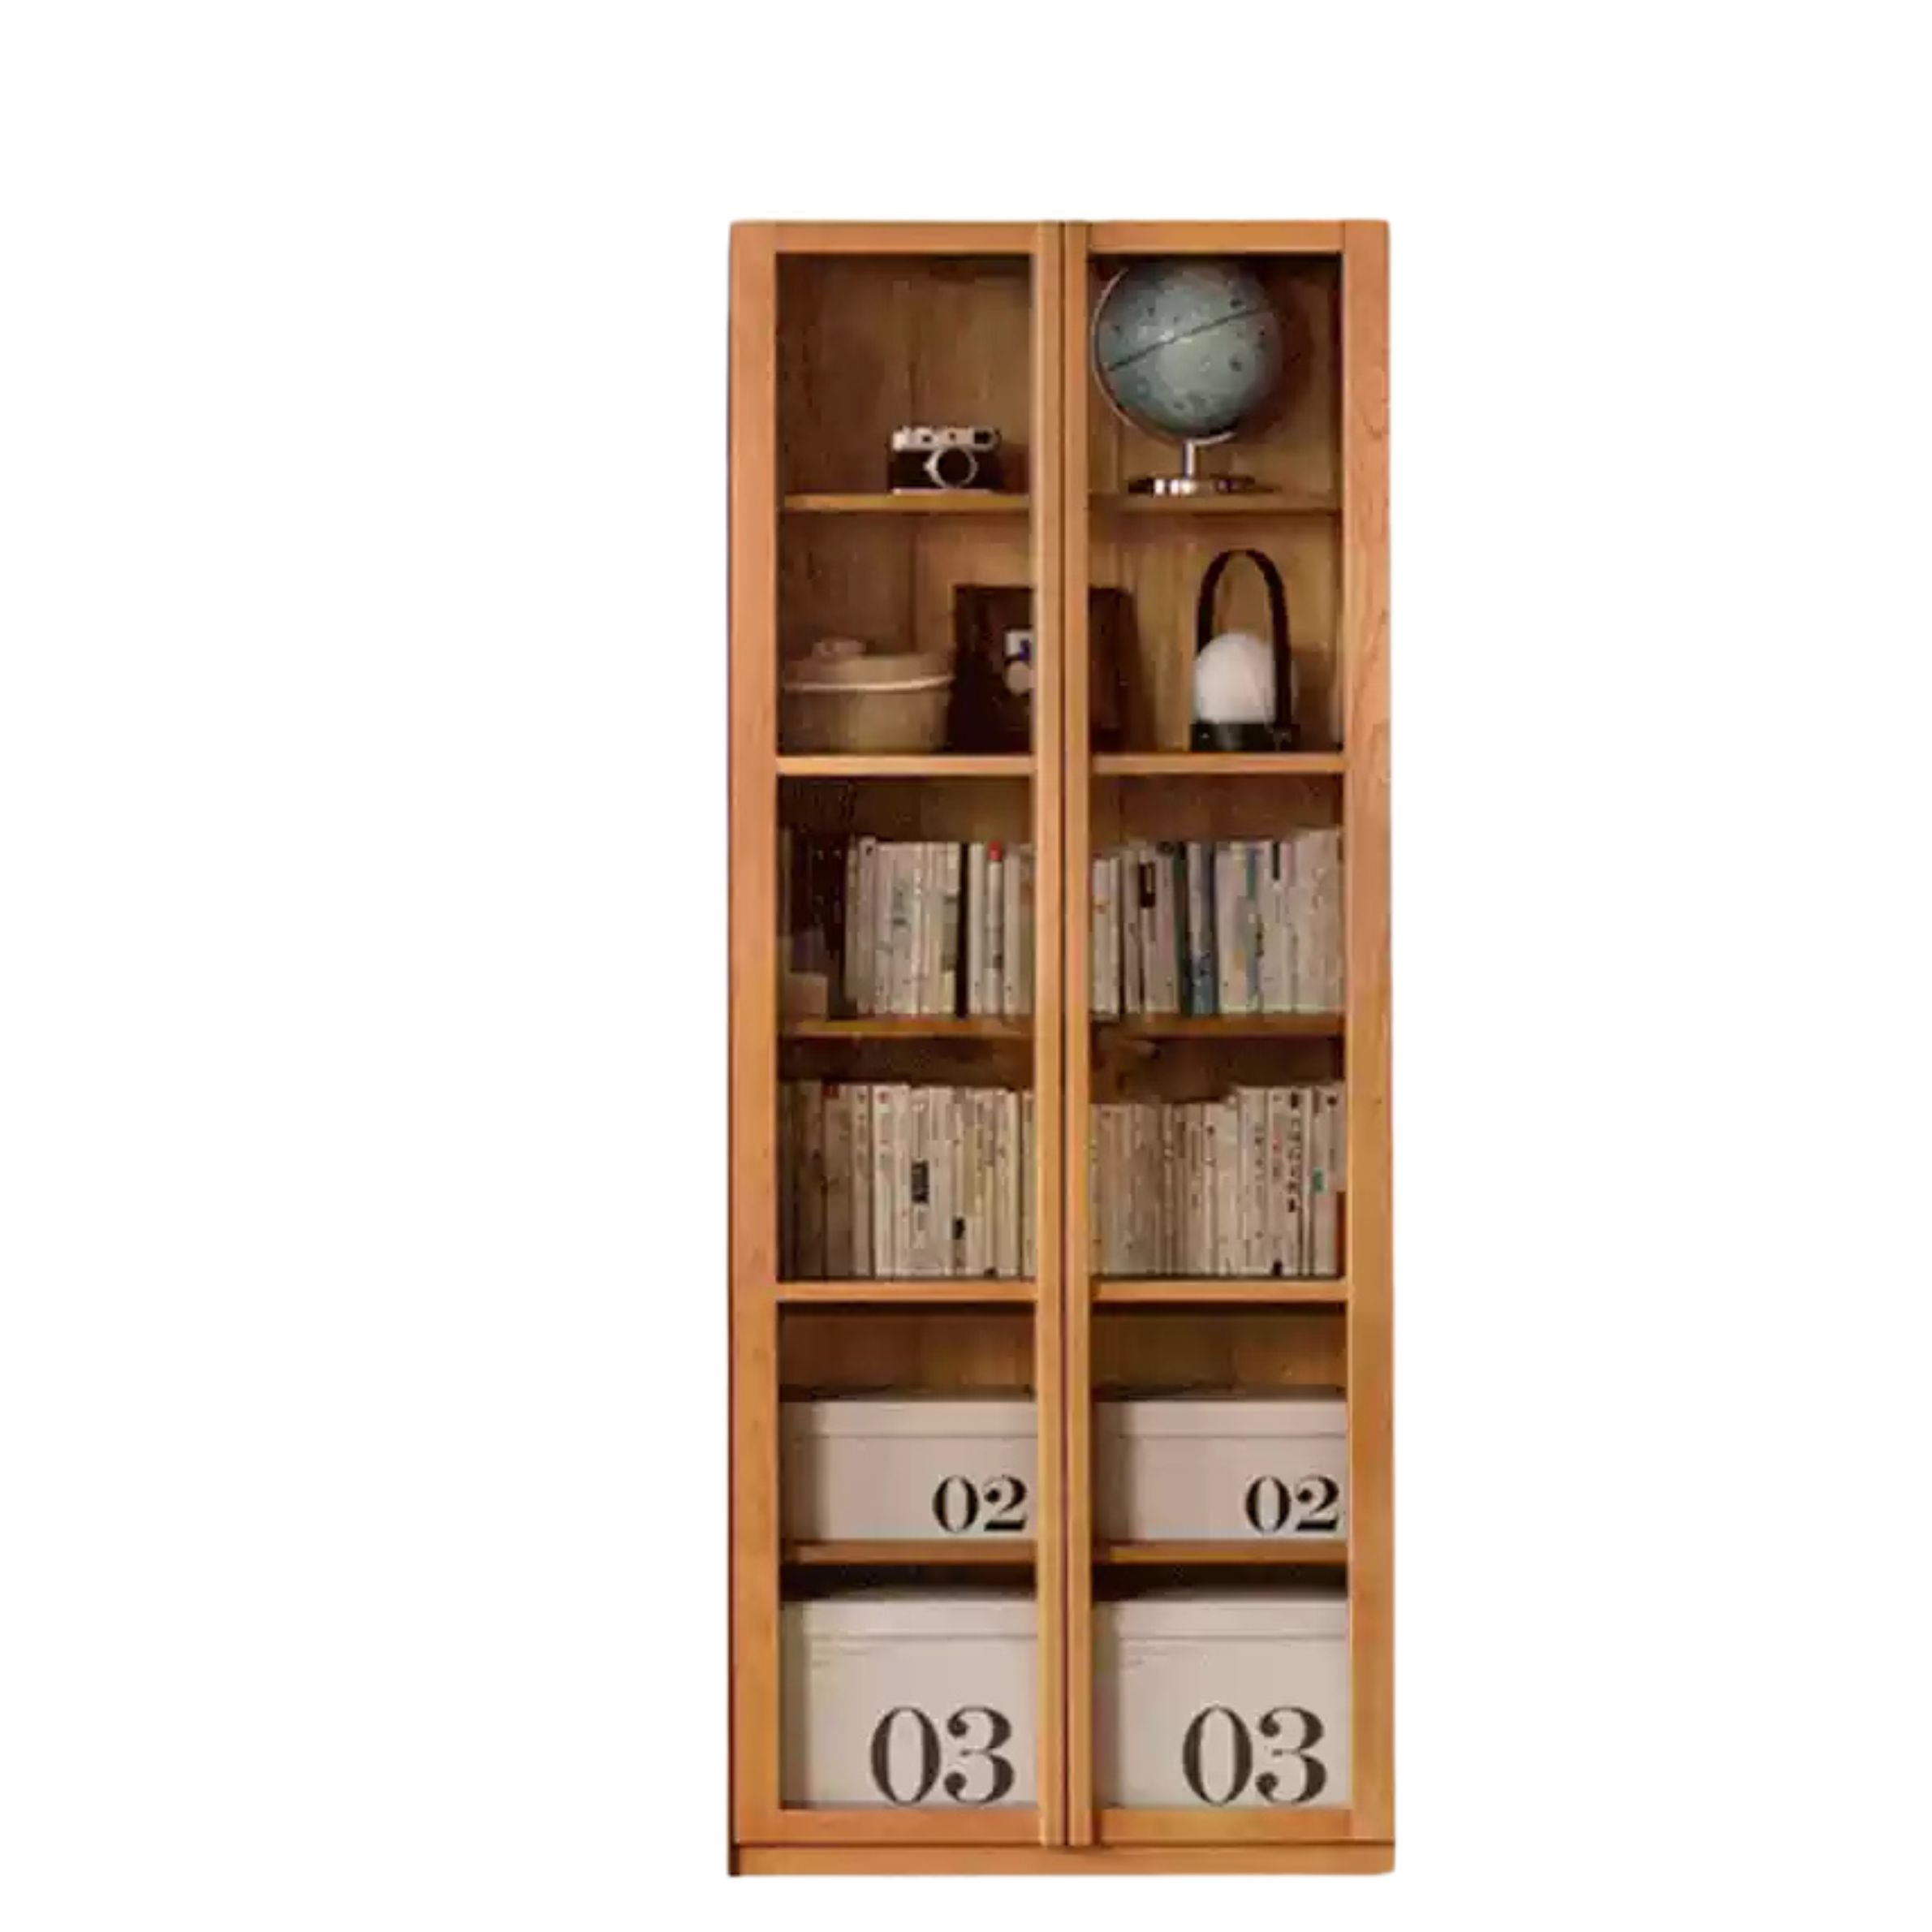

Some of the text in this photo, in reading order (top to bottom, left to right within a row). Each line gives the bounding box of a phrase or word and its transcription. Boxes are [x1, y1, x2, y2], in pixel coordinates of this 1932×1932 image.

[932, 1475, 1029, 1533] 02
[1244, 1474, 1341, 1533] 02
[870, 1706, 1015, 1805] 03
[1182, 1706, 1327, 1805] 03
